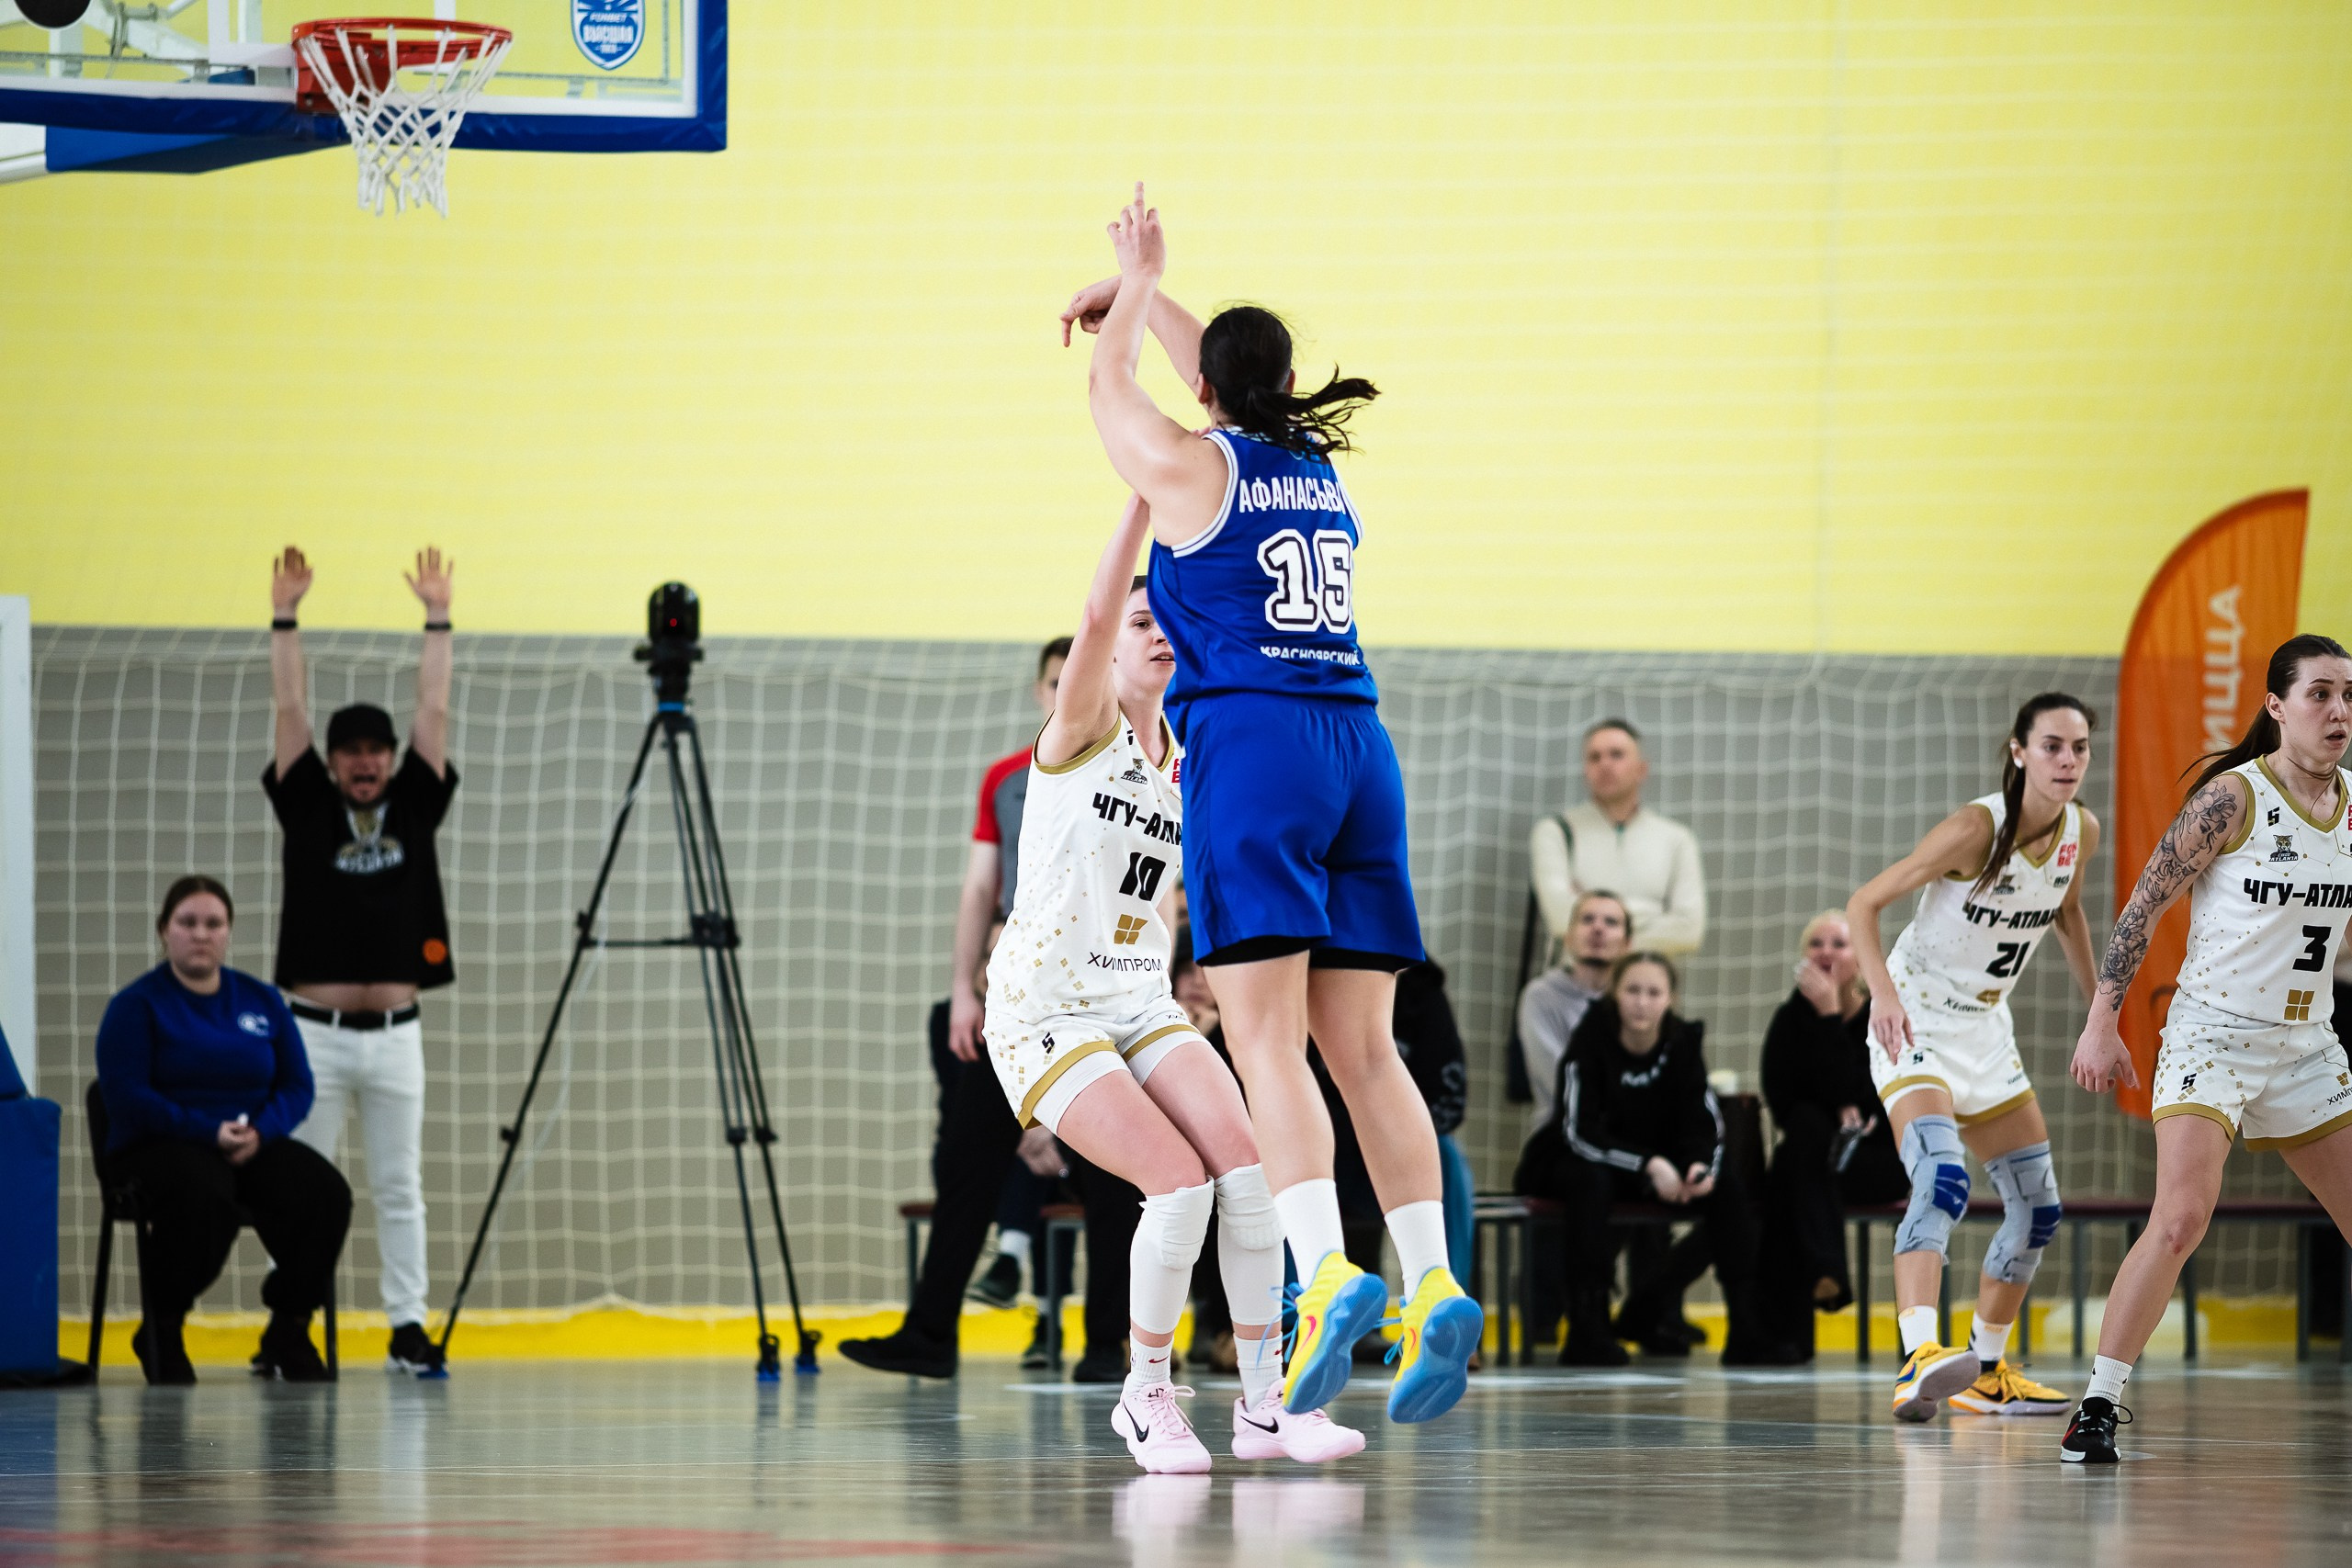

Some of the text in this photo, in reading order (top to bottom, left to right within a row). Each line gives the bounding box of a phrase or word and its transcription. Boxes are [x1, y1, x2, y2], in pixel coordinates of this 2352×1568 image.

[1257, 528, 1354, 635] 15
[2203, 585, 2245, 770] ИЦЦА
[1119, 852, 1167, 902] 10
[1984, 941, 2030, 978] 21
[2291, 924, 2333, 973] 3
